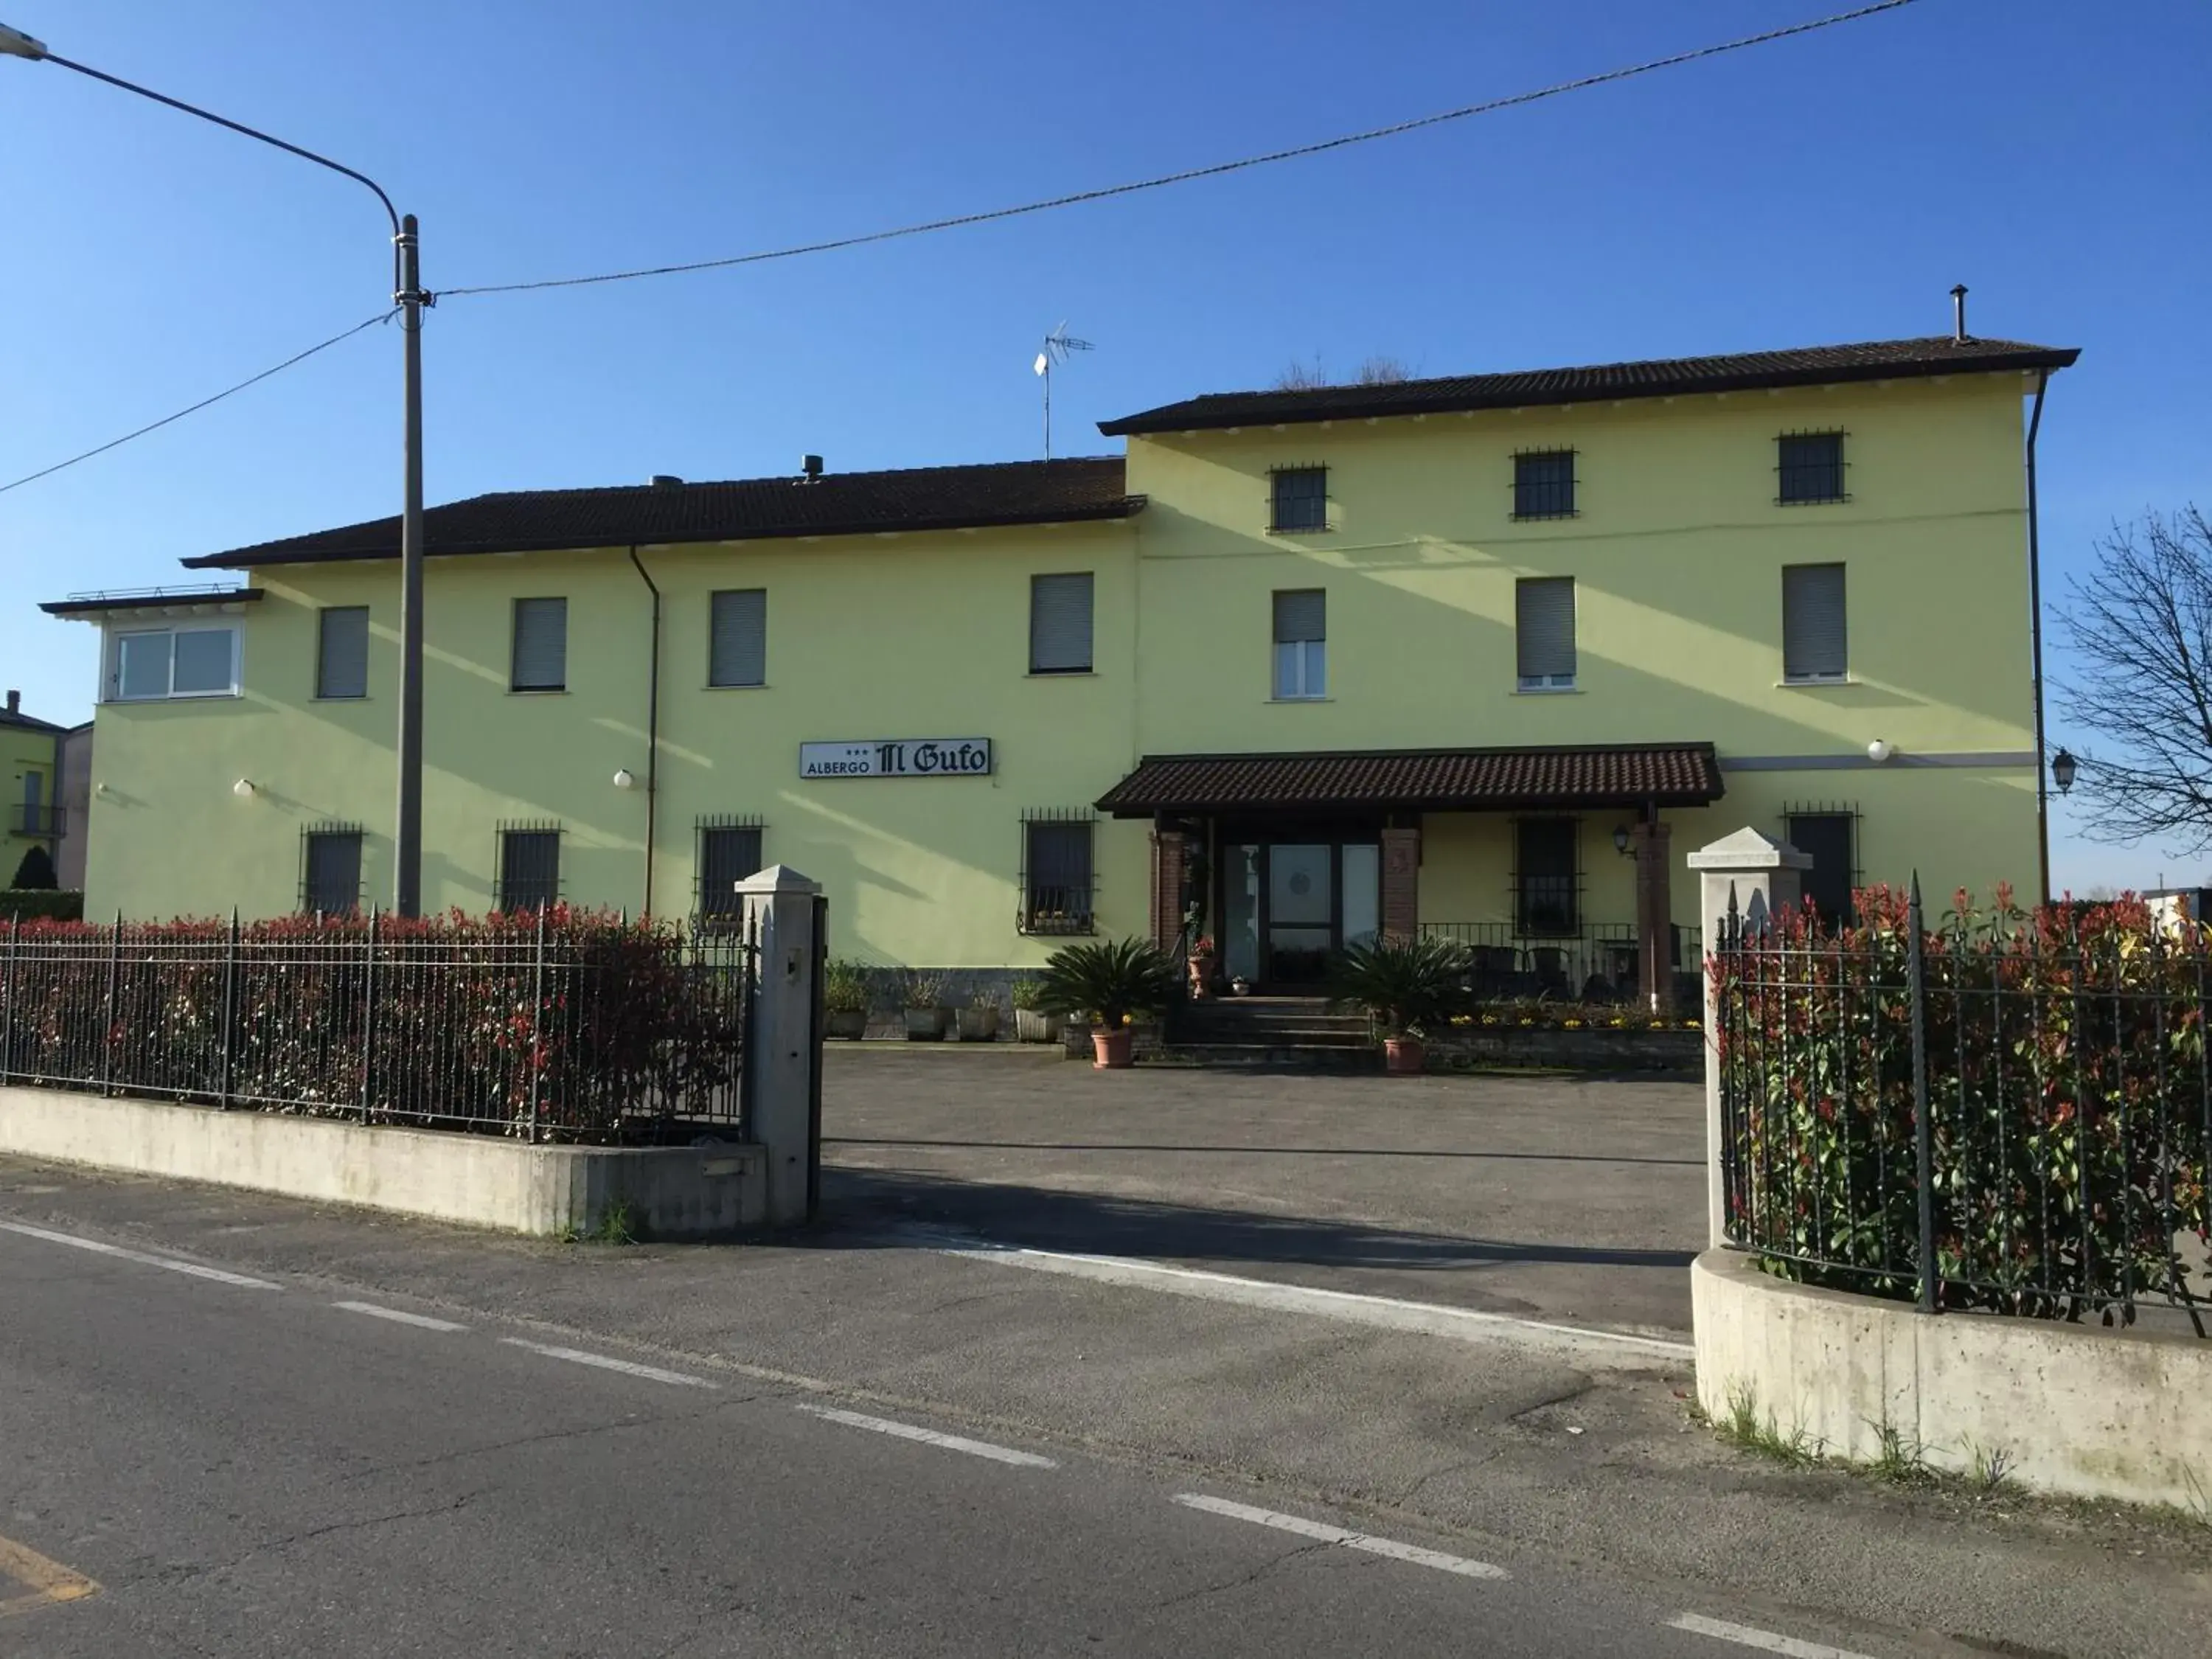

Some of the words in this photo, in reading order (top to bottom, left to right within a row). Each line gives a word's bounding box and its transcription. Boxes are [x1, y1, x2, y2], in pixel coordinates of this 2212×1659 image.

[807, 761, 869, 774] ALBERGO
[876, 743, 905, 773] Il
[914, 743, 986, 772] Gufo
